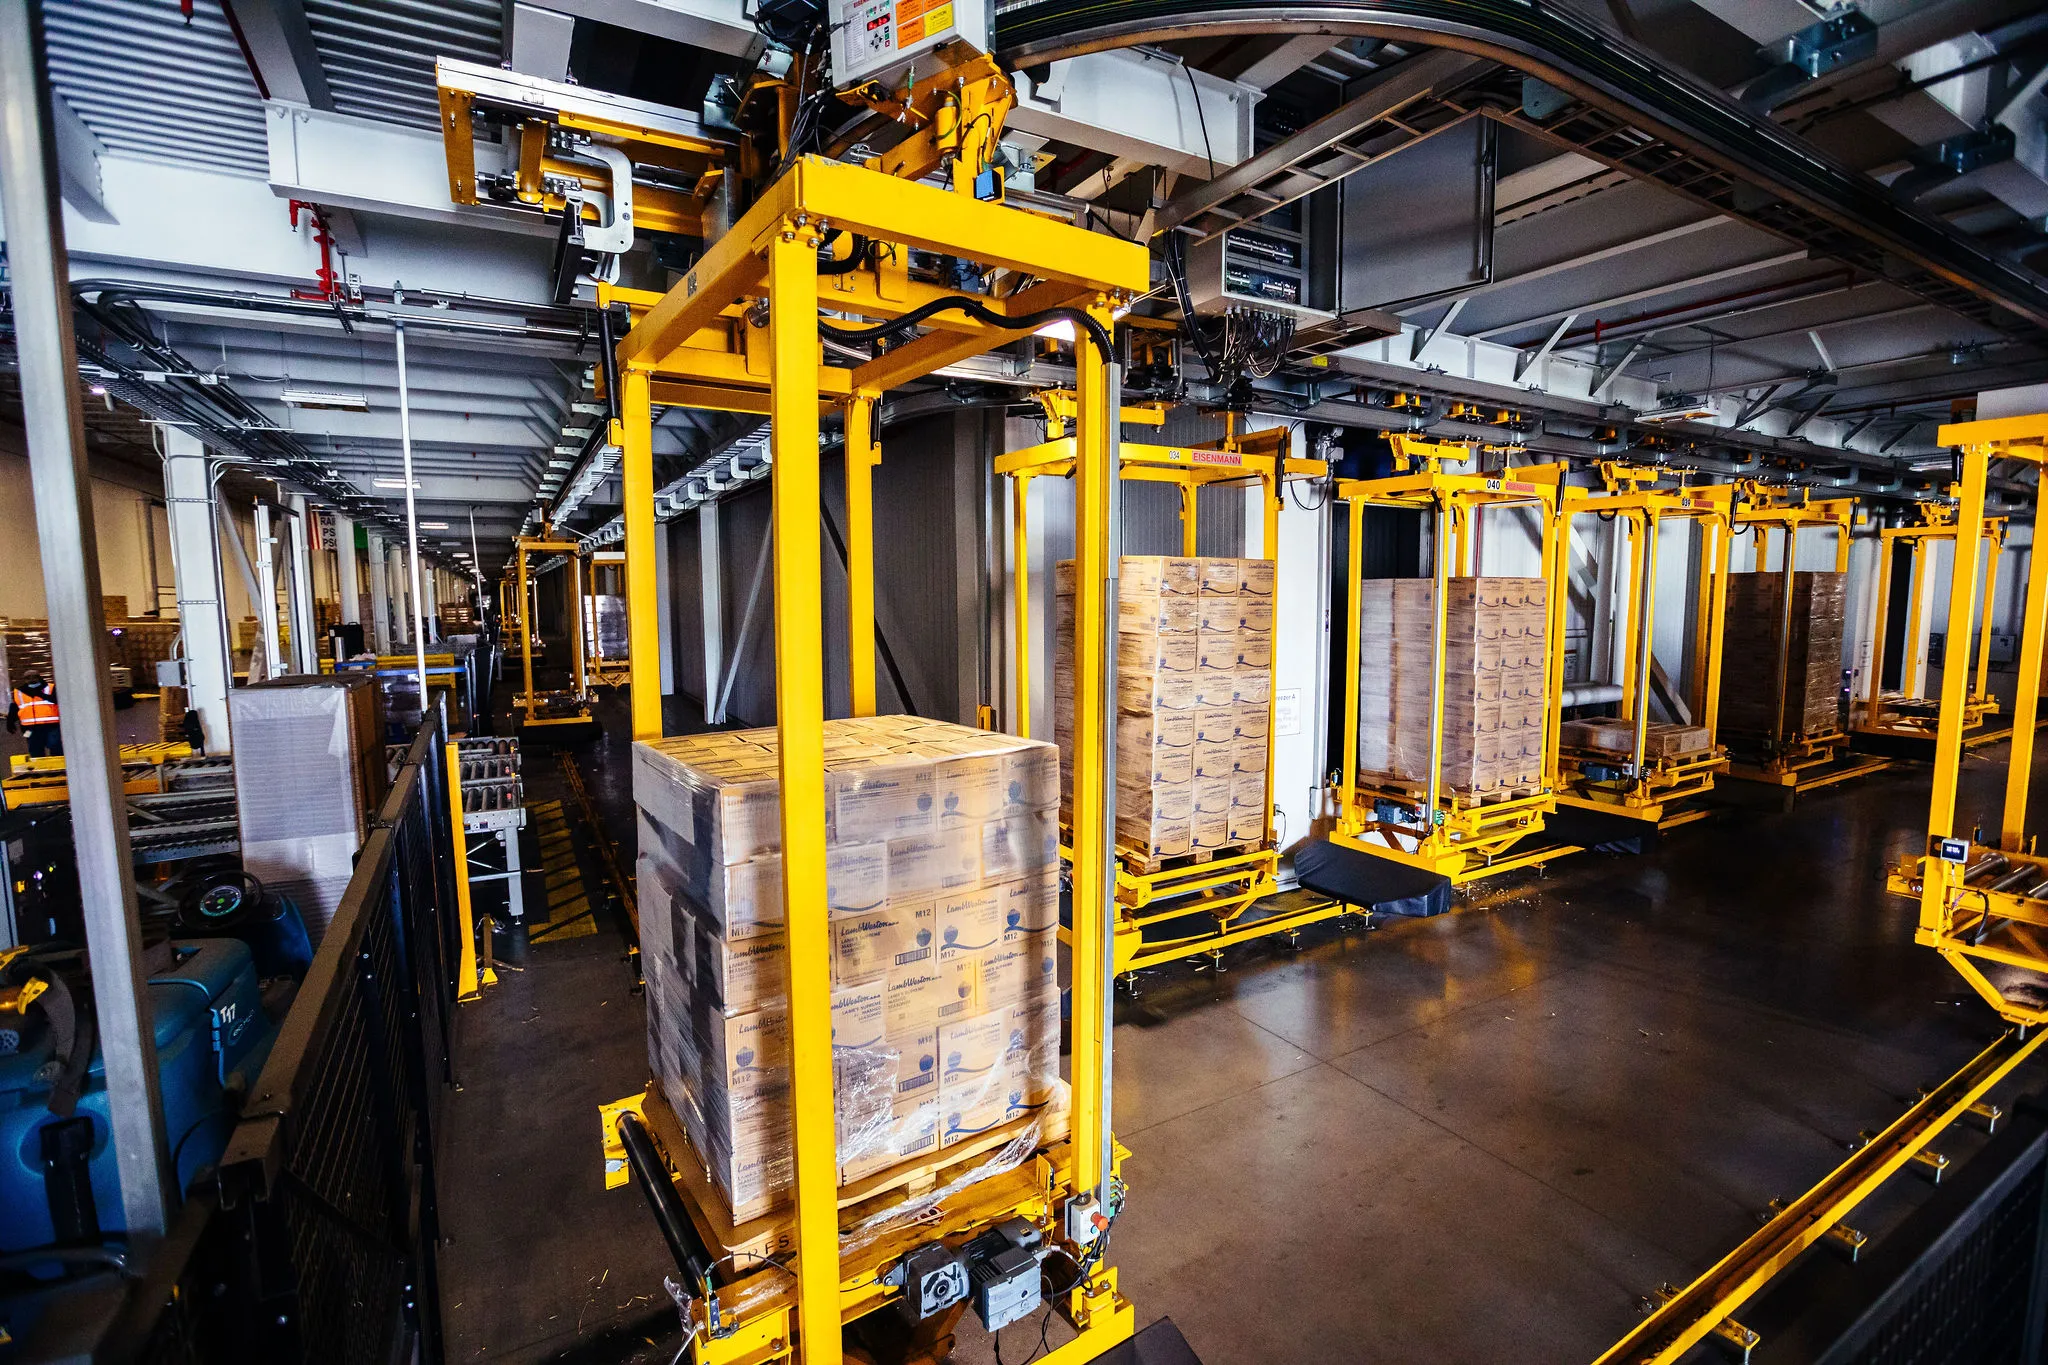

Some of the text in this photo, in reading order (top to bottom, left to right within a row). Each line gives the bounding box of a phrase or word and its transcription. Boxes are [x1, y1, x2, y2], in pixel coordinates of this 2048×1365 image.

[1193, 452, 1241, 465] EISENMANN
[1486, 479, 1501, 490] 040
[915, 908, 932, 919] M12
[731, 926, 751, 938] M12
[840, 920, 888, 937] LambWeston
[1003, 932, 1018, 942] M12
[940, 949, 956, 959] M12
[887, 975, 931, 992] LambWeston
[831, 994, 869, 1010] ambWeston
[220, 1002, 236, 1023] T17
[732, 1074, 751, 1085] M12
[943, 1073, 959, 1084] M12
[1005, 1110, 1020, 1120] M12
[944, 1134, 959, 1146] M12
